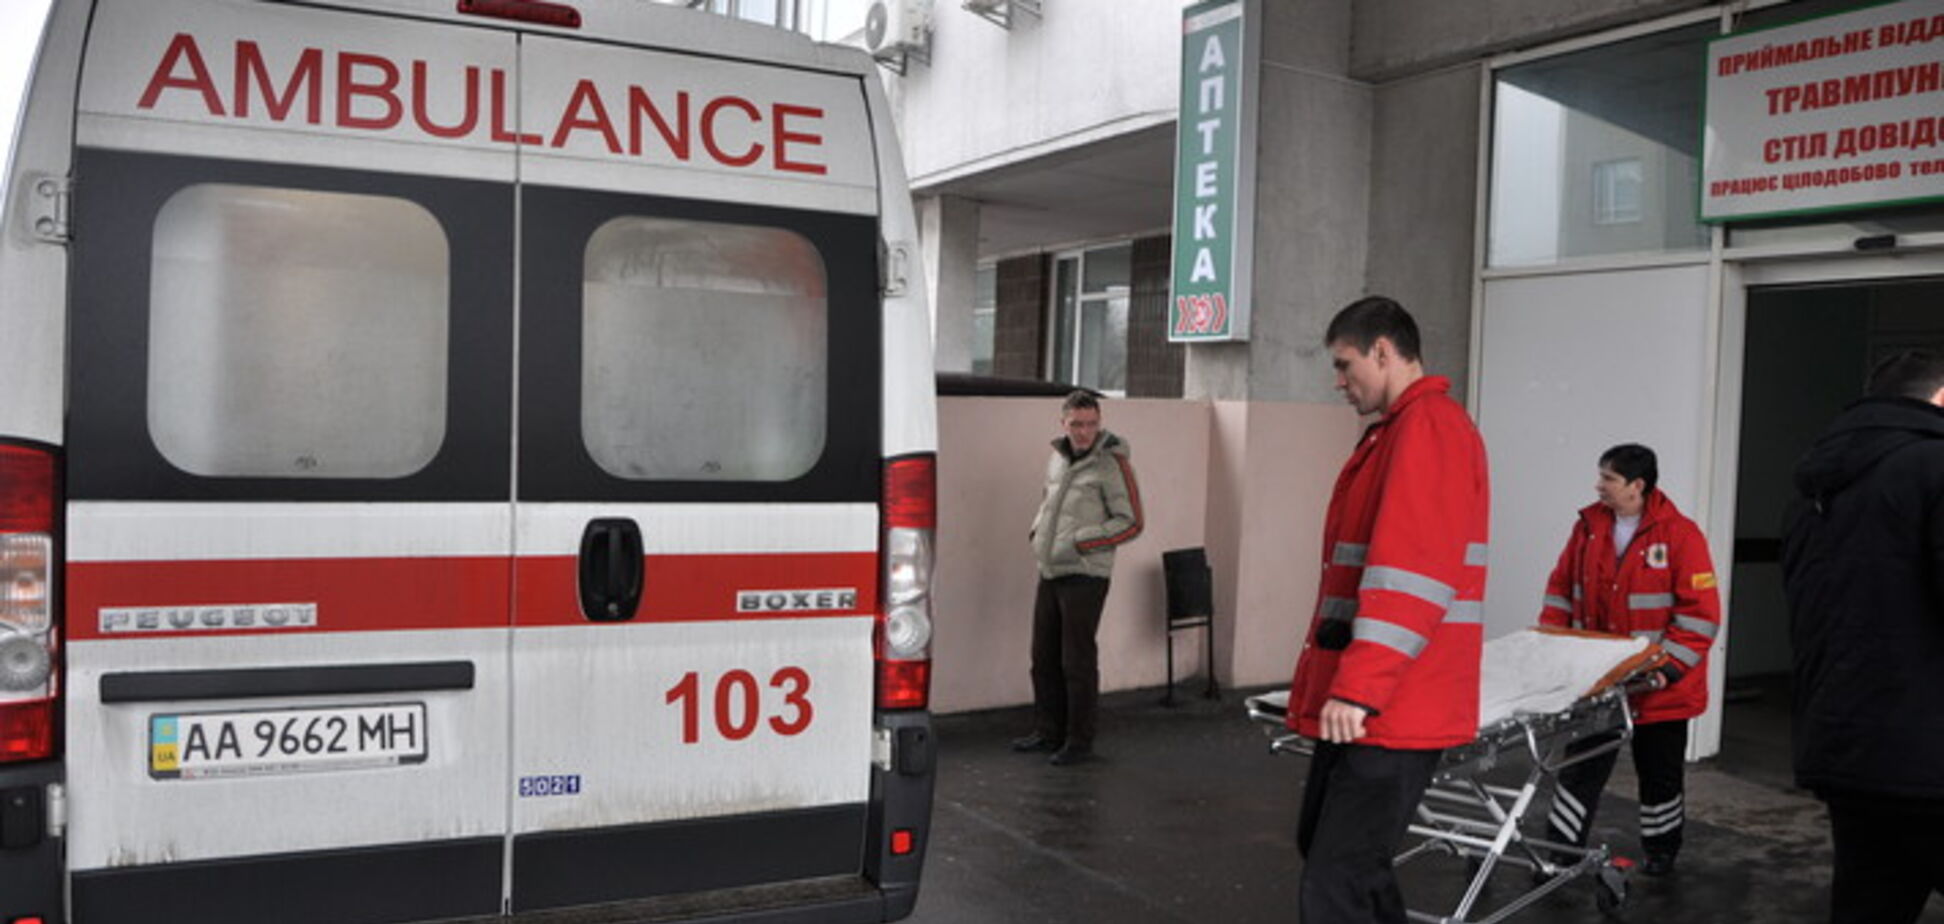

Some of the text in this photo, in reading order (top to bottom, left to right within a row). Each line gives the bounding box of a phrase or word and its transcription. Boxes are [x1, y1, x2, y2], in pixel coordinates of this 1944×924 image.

[1718, 29, 1874, 76] ПРИЙМАЛЬНЕ
[137, 33, 827, 175] AMBULANCE
[1765, 61, 1944, 116] ТРАВМПУН
[1190, 34, 1226, 283] АПТЕКА
[1763, 133, 1828, 164] СТІЛ
[1710, 175, 1778, 197] ПРАЦЮЄ
[1782, 161, 1901, 192] ЦІЛОДОБОВО
[103, 608, 313, 631] PEUGEOT
[741, 591, 856, 610] BOXER
[665, 666, 813, 744] 103
[183, 712, 415, 761] AA 9662 MH
[520, 776, 580, 796] 5021
